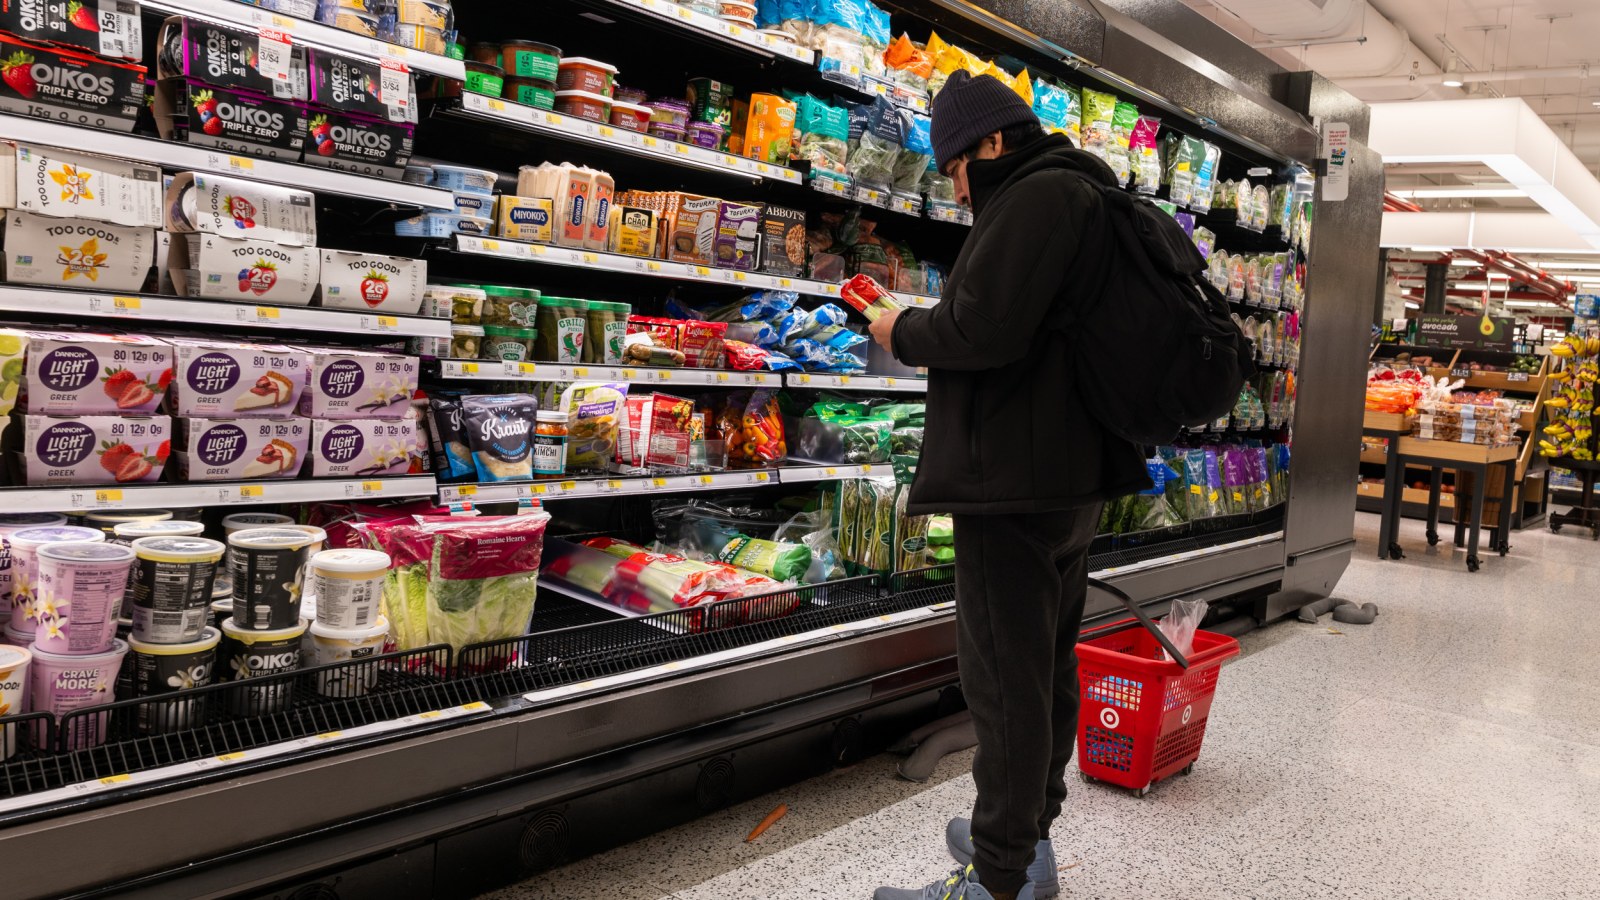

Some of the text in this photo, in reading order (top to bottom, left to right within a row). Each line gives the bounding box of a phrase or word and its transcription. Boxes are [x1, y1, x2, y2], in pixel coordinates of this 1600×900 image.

[20, 0, 36, 32] OIK
[102, 12, 115, 34] 15g
[260, 28, 283, 41] Sale!
[207, 29, 221, 77] OIKOS
[260, 52, 279, 64] 3/$4
[220, 54, 228, 75] TRIPLE
[380, 58, 401, 69] Sale!
[30, 63, 114, 96] OIKOS
[331, 58, 344, 102] OIKOS
[383, 81, 400, 91] 3/$4
[36, 83, 75, 99] TRIPLE
[77, 91, 108, 105] ZERO
[28, 105, 51, 119] 15g
[216, 102, 284, 131] OIKOS
[848, 114, 868, 123] rganic
[221, 120, 280, 139] TRIPLE ZERO
[330, 125, 391, 151] OIKOS
[214, 140, 234, 150] 15g
[334, 142, 387, 158] TRIPLE ZERO
[63, 175, 79, 194] 2G
[38, 187, 50, 207] TOO
[232, 200, 246, 219] 2G
[688, 199, 716, 209] TOFURKY
[513, 209, 546, 222] MIYOKO'S
[729, 208, 755, 217] TOFURKY
[765, 205, 805, 221] ABBOT'S
[213, 211, 222, 229] TOO
[627, 217, 646, 227] CHAO
[46, 225, 74, 237] TOO
[69, 248, 95, 267] 2G
[232, 247, 255, 258] TOO
[347, 260, 368, 271] TOO
[251, 268, 272, 284] 2G
[365, 279, 384, 294] 2G
[1421, 322, 1458, 331] avocado
[113, 350, 126, 360] 80
[131, 351, 148, 363] 12g
[152, 352, 165, 362] 0g
[49, 359, 91, 376] LIGHT
[253, 357, 265, 366] 80
[270, 357, 284, 368] 12g
[287, 358, 299, 368] 0g
[375, 362, 386, 372] 80
[389, 362, 401, 373] 12g
[196, 365, 234, 380] LIGHT
[404, 363, 413, 373] 0g
[61, 373, 86, 387] FIT
[328, 370, 358, 385] LIGHT
[206, 378, 229, 390] FIT
[336, 383, 354, 395] FIT
[580, 408, 613, 418] Dumplings
[111, 424, 125, 434] 80
[130, 424, 146, 435] 12g
[150, 425, 162, 435] 0g
[210, 428, 239, 436] DANNON
[259, 425, 271, 435] 80
[275, 425, 288, 436] 12g
[292, 426, 303, 436] 0g
[331, 428, 356, 436] DANNON
[373, 425, 384, 435] 80
[386, 426, 399, 436] 12g
[401, 427, 410, 436] 0g
[481, 418, 529, 441] Kraut
[47, 434, 89, 452] LIGHT
[205, 436, 241, 451] LIGHT
[328, 436, 358, 451] LIGHT
[58, 448, 83, 463] FIT
[214, 448, 235, 462] FIT
[336, 448, 354, 460] FIT
[48, 469, 75, 477] GREEK
[477, 535, 526, 545] Romaine Hearts
[725, 539, 747, 564] RGANIC
[247, 649, 300, 670] OIKOS
[62, 668, 101, 679] CRAVE
[55, 678, 97, 690] MORE
